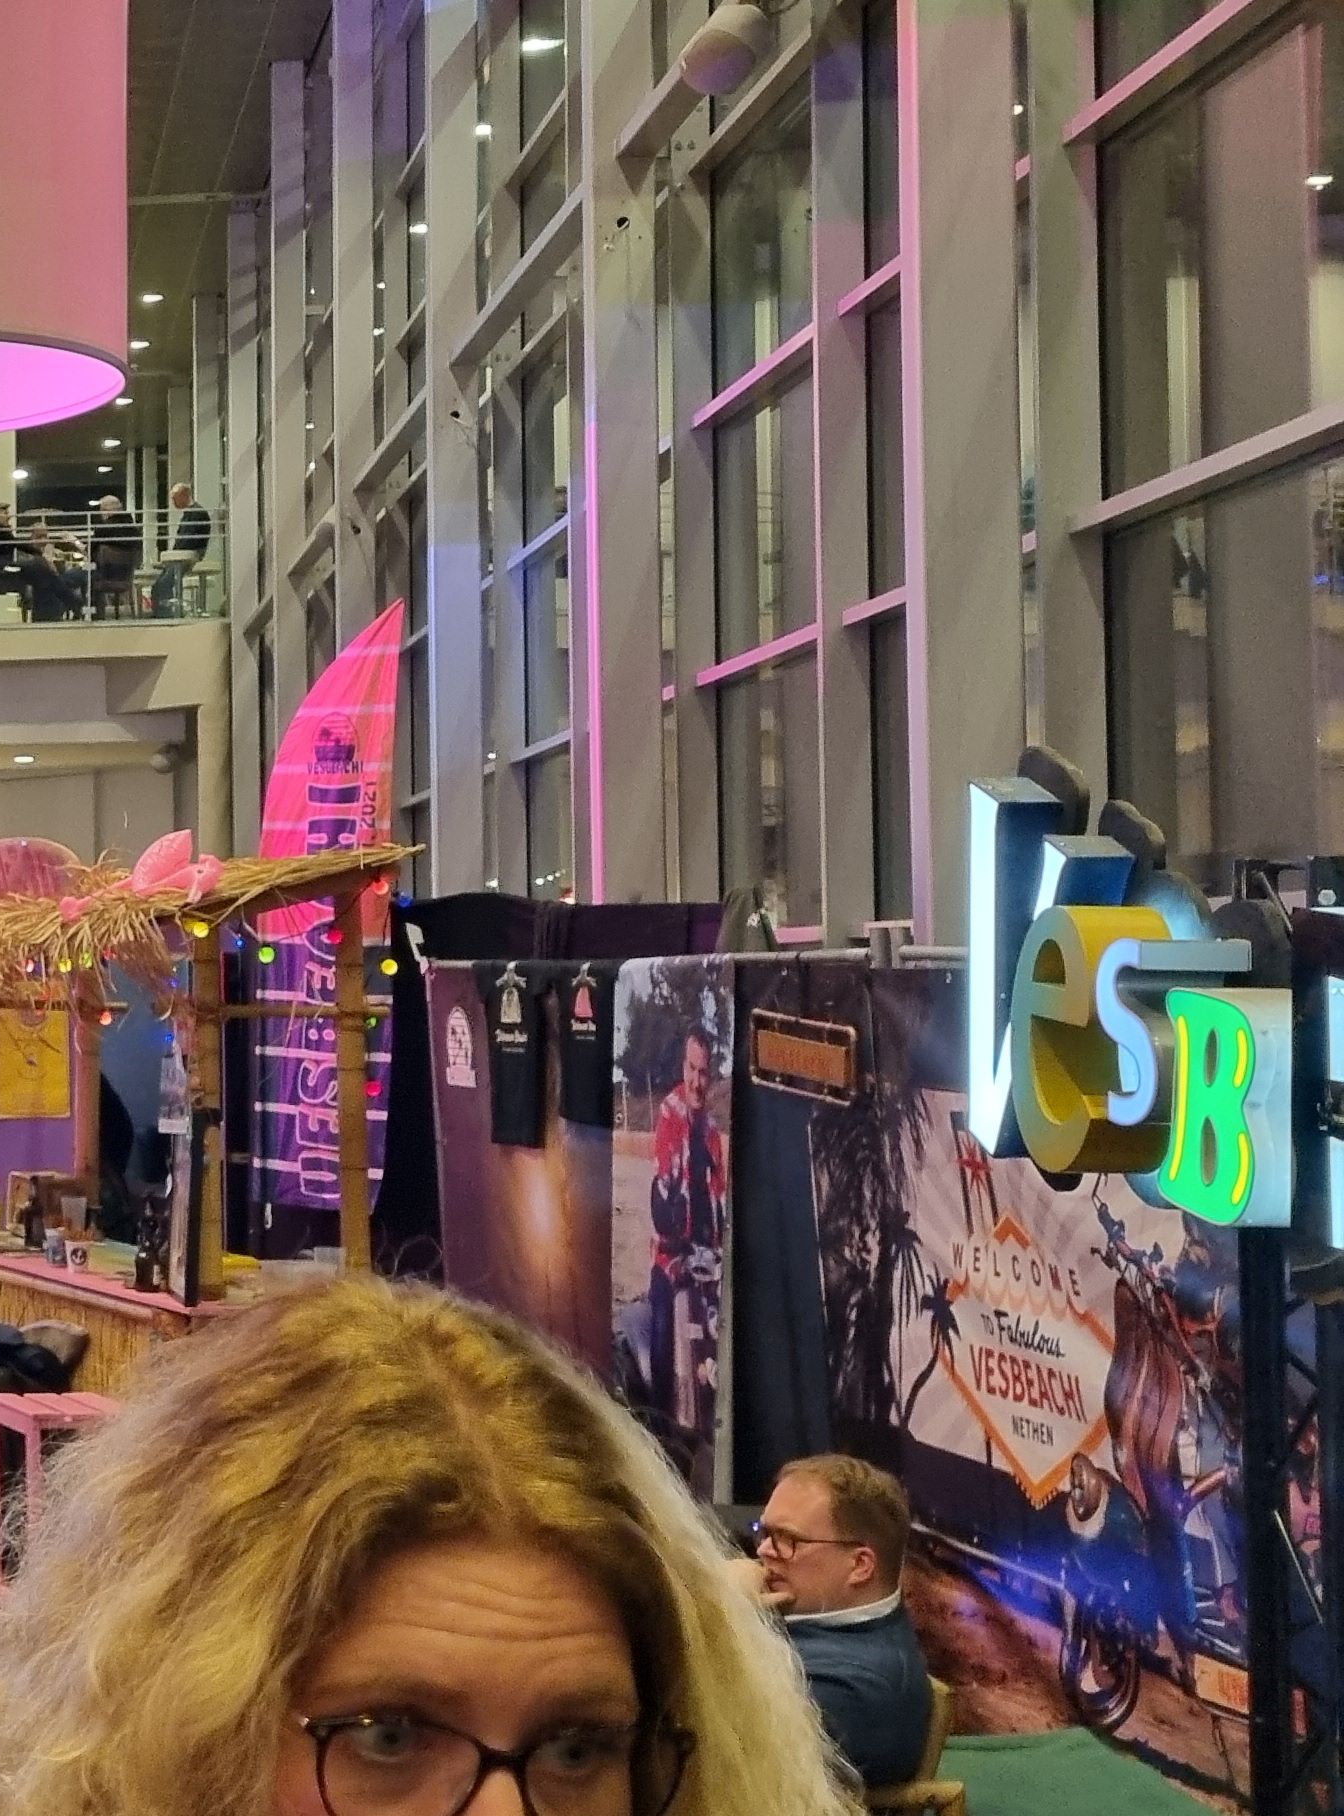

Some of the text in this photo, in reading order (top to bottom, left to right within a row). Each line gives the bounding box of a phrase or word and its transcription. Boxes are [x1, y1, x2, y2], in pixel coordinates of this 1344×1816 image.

[952, 1241, 1081, 1297] WELCOME
[980, 1309, 1066, 1359] TO Fabulous
[969, 1343, 1089, 1424] VESBEACHI
[1011, 1414, 1054, 1447] NETHEN
